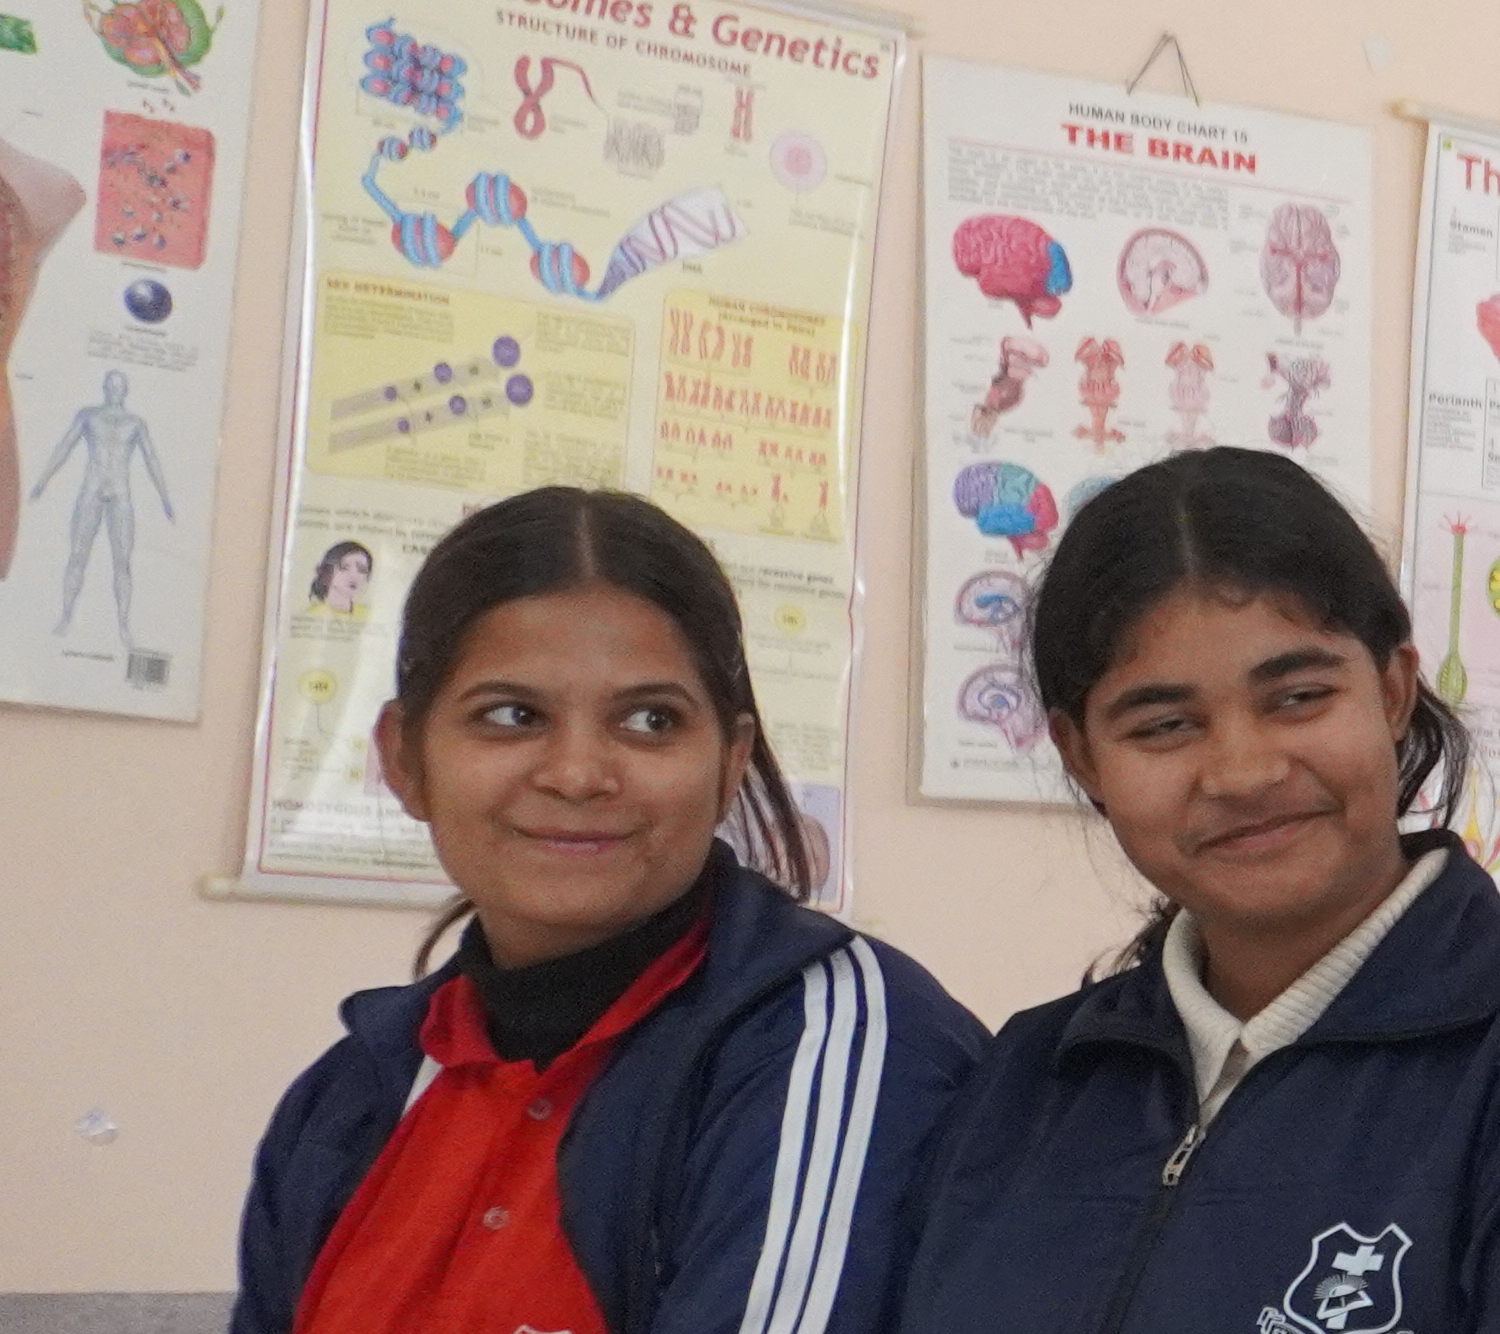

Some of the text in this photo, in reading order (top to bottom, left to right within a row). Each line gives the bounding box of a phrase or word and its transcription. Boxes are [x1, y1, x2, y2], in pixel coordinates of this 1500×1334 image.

[496, 9, 751, 75] STRUCTURE OF CHROMOSOME
[669, 3, 696, 38] &
[712, 12, 880, 78] Genetics
[1068, 102, 1125, 123] HUMAN
[1131, 114, 1171, 131] BODY
[1177, 121, 1227, 140] CHART
[1061, 122, 1256, 175] THE BRAIN
[1428, 392, 1482, 410] Perianth
